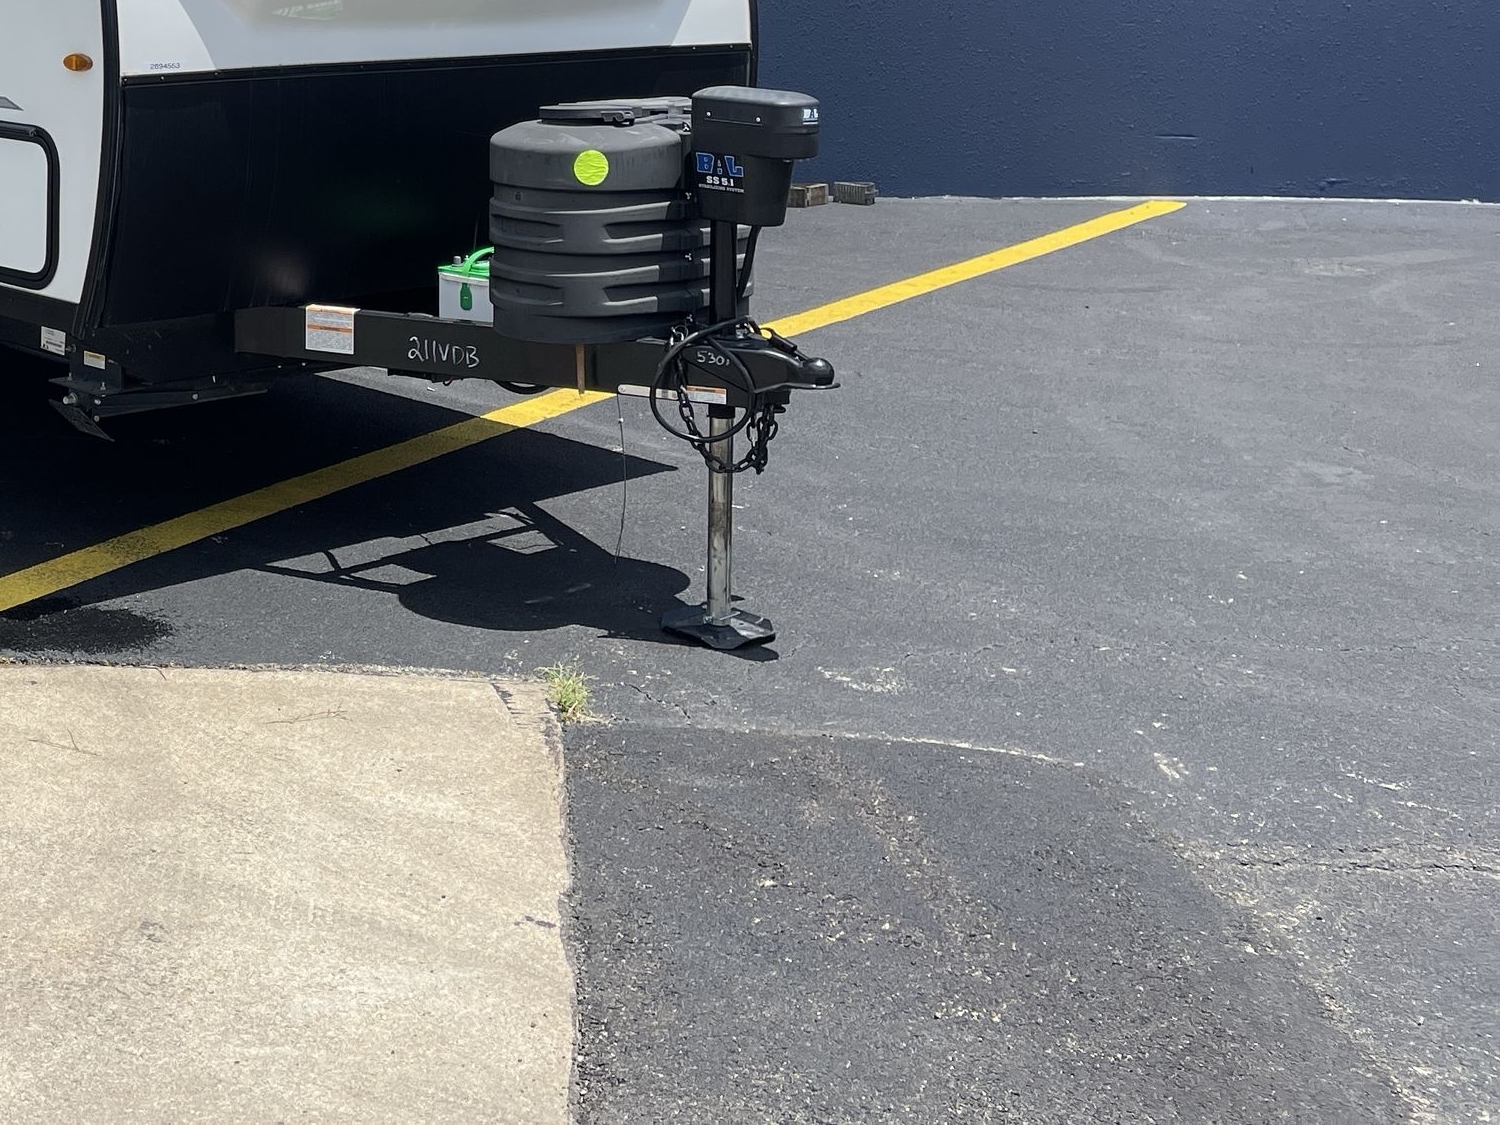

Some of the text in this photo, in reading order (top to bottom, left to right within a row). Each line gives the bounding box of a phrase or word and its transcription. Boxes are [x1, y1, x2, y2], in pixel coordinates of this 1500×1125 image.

[696, 152, 744, 177] BAL
[706, 175, 720, 185] SS
[408, 336, 480, 368] 211VDB
